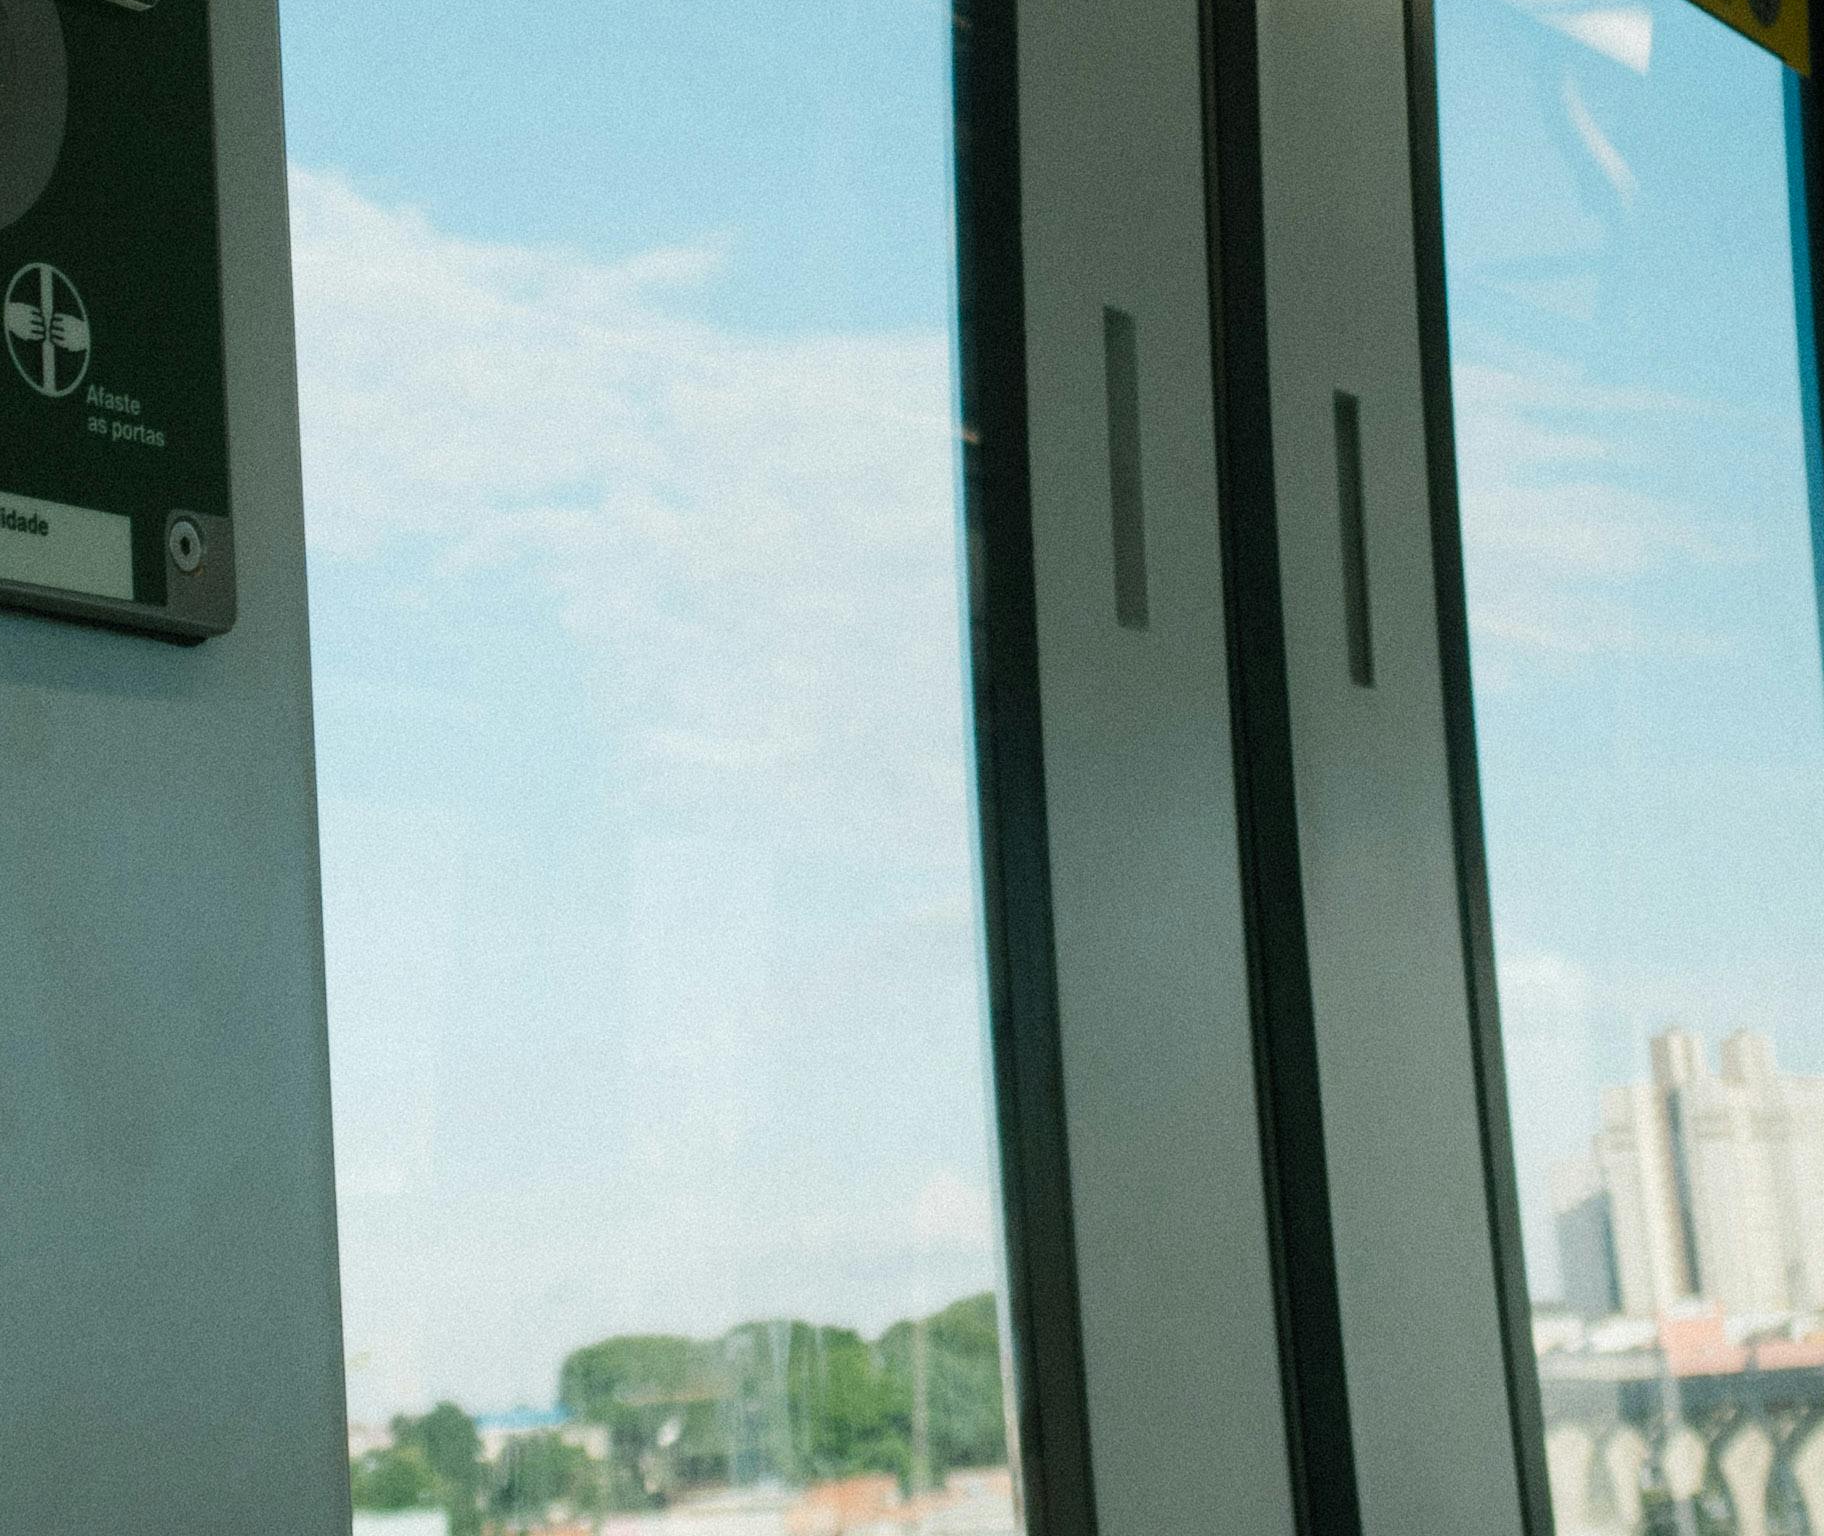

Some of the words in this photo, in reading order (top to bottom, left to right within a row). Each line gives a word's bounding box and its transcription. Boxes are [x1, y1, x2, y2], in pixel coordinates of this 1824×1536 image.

[85, 384, 142, 417] Afaste
[86, 414, 108, 435] as
[112, 418, 167, 449] portas
